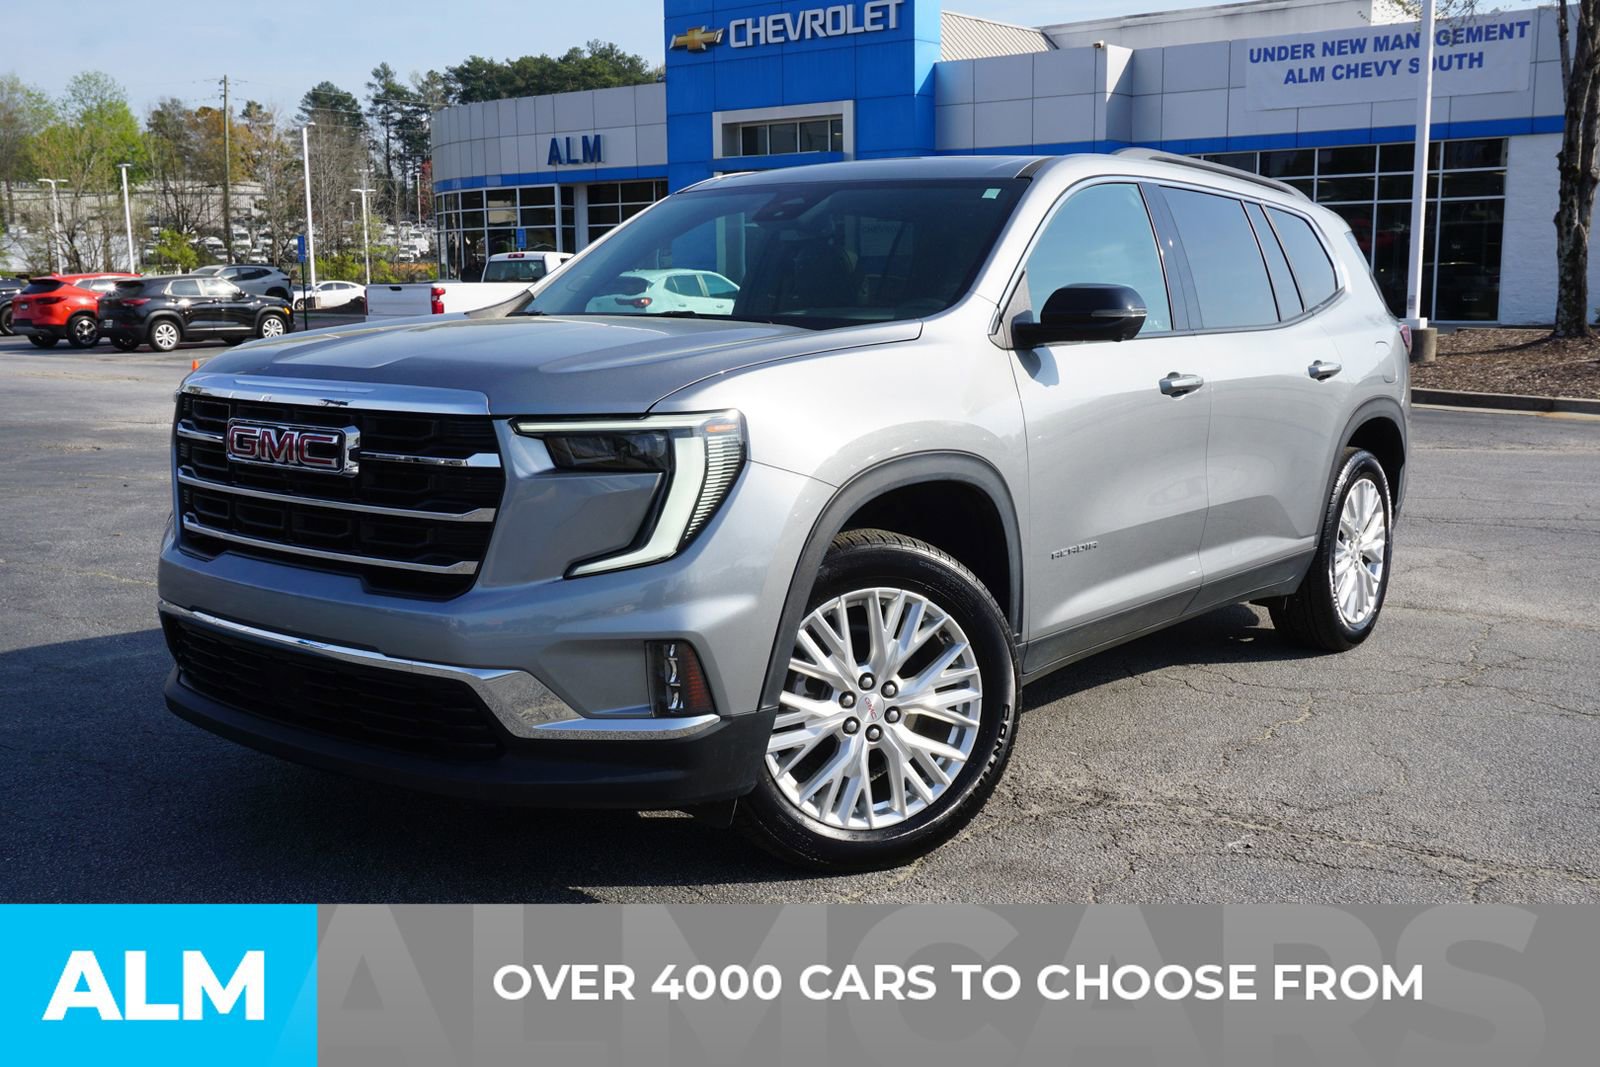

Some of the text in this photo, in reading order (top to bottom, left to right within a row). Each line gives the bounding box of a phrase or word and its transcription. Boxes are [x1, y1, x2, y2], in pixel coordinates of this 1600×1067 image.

[729, 0, 904, 48] CHEVROLET
[1249, 21, 1531, 64] UNDER NEW MANGEMENT
[1283, 52, 1484, 85] ALM CHEVY SUTH
[547, 134, 602, 166] ALM
[229, 425, 339, 469] GMC
[864, 696, 877, 720] GMC
